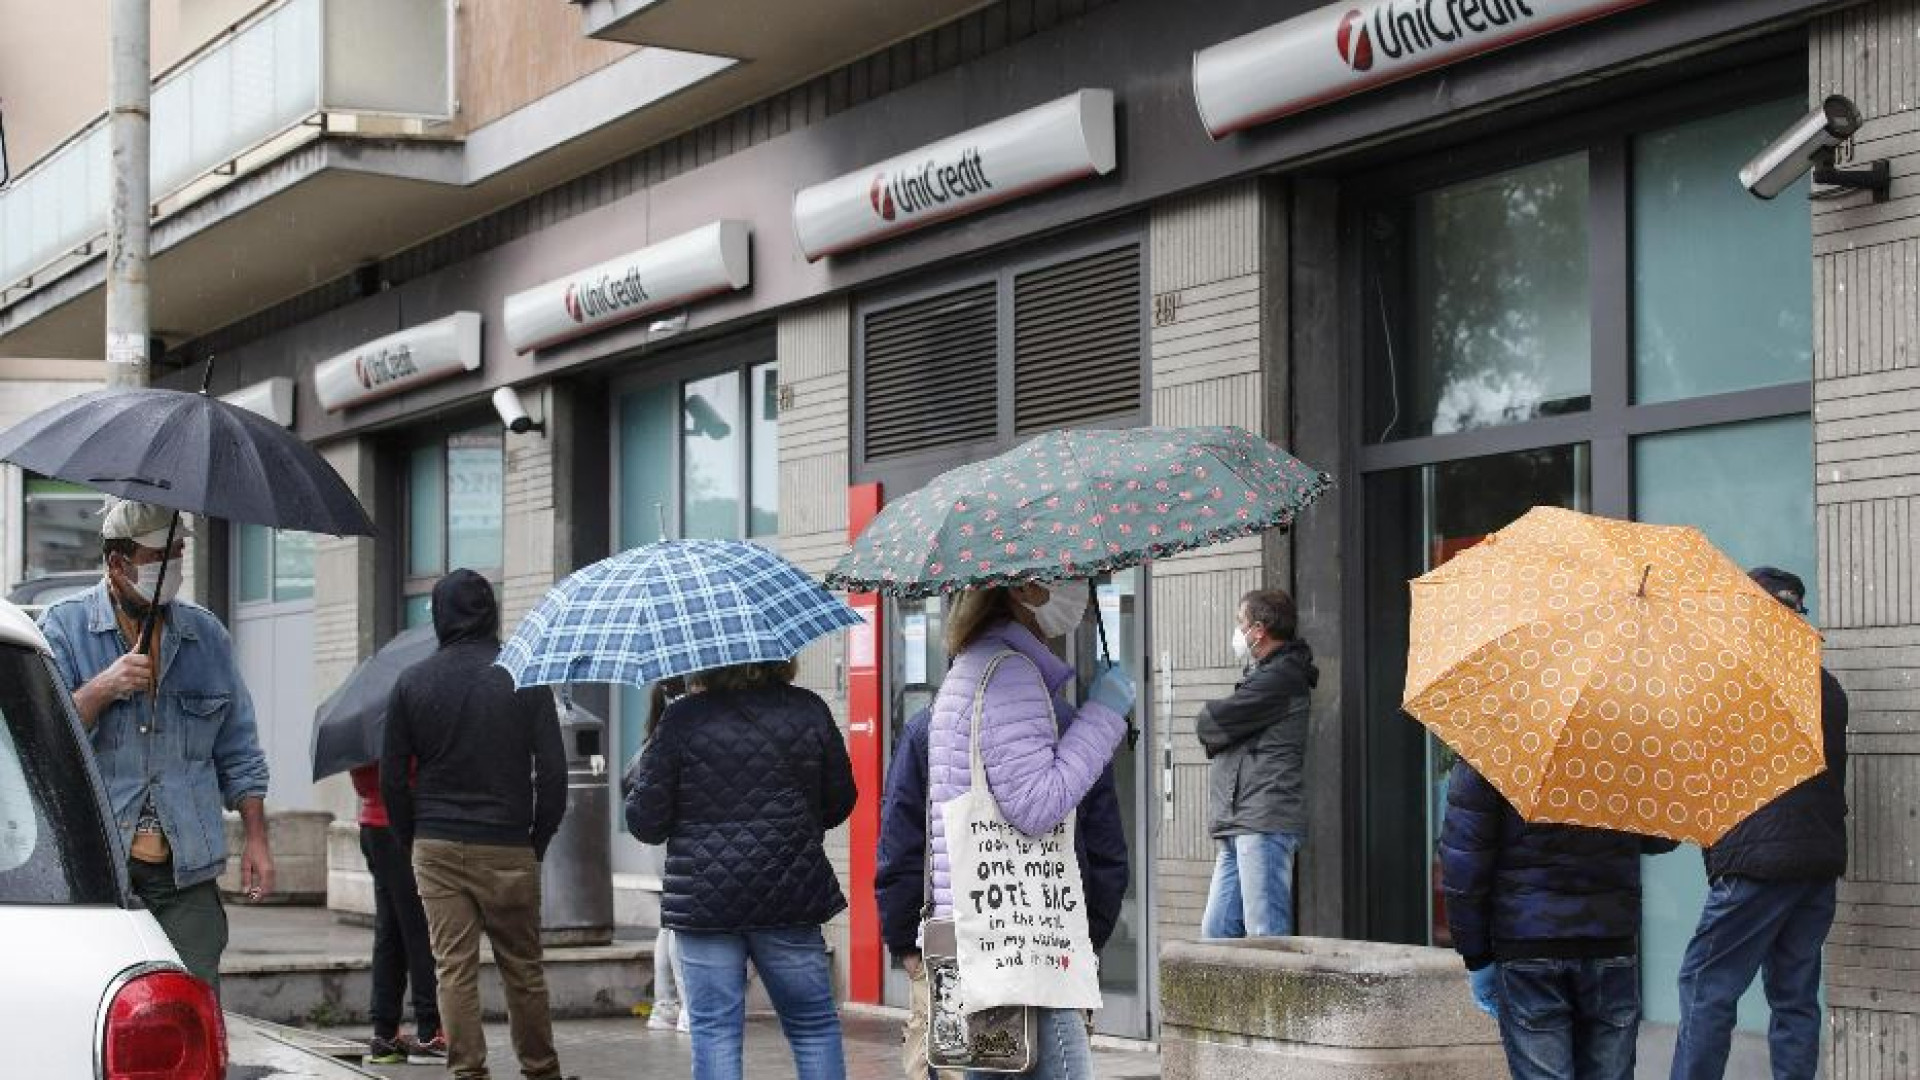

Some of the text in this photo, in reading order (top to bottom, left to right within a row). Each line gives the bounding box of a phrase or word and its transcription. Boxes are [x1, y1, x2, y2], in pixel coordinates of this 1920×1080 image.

[892, 146, 992, 213] UniCredit
[581, 266, 649, 318] UniCredit
[977, 859, 1015, 881] one
[969, 880, 1077, 914] TOTE BAG
[989, 914, 1005, 930] in
